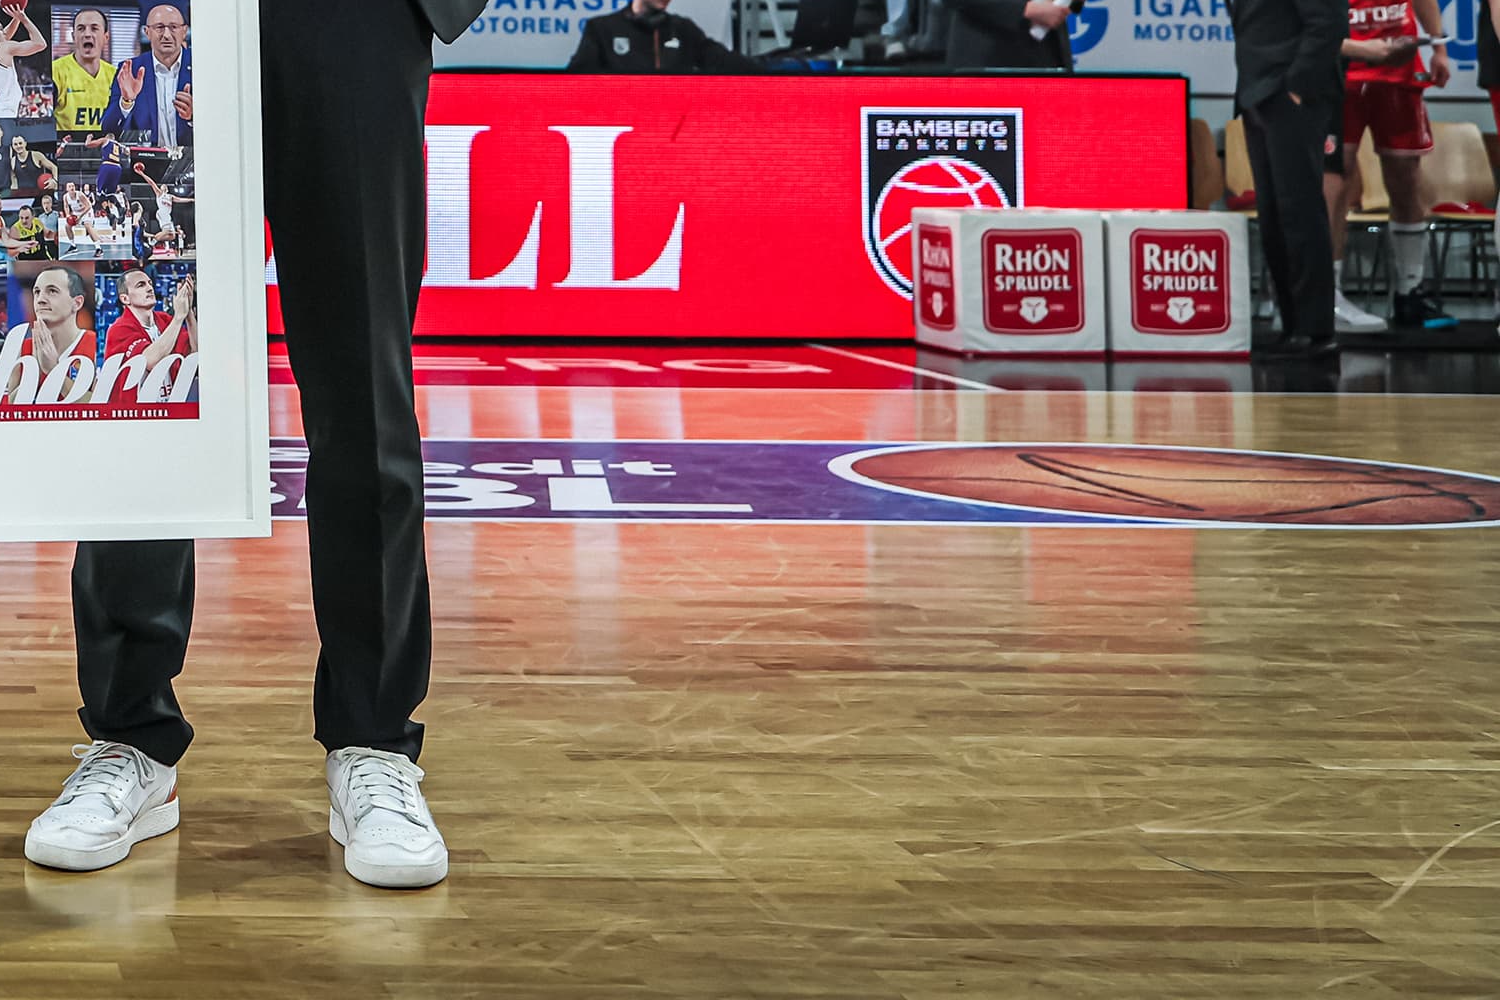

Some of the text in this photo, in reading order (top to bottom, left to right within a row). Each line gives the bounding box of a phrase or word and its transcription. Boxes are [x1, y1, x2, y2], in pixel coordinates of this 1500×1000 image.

[471, 17, 570, 35] OTOREN
[1133, 23, 1235, 42] MOTORE
[75, 107, 105, 126] EW
[875, 119, 1009, 138] BAMBERG
[876, 138, 1009, 151] BASKETS
[993, 243, 1070, 272] RHÖN
[1141, 243, 1217, 273] RHÖN
[994, 274, 1072, 292] SPRUDEL
[1141, 274, 1219, 292] SPRUDEL
[13, 410, 25, 420] VS.
[27, 410, 79, 419] SYNTAINICS
[81, 410, 100, 419] MBC
[111, 409, 139, 418] BROSE
[141, 409, 169, 418] ARENA
